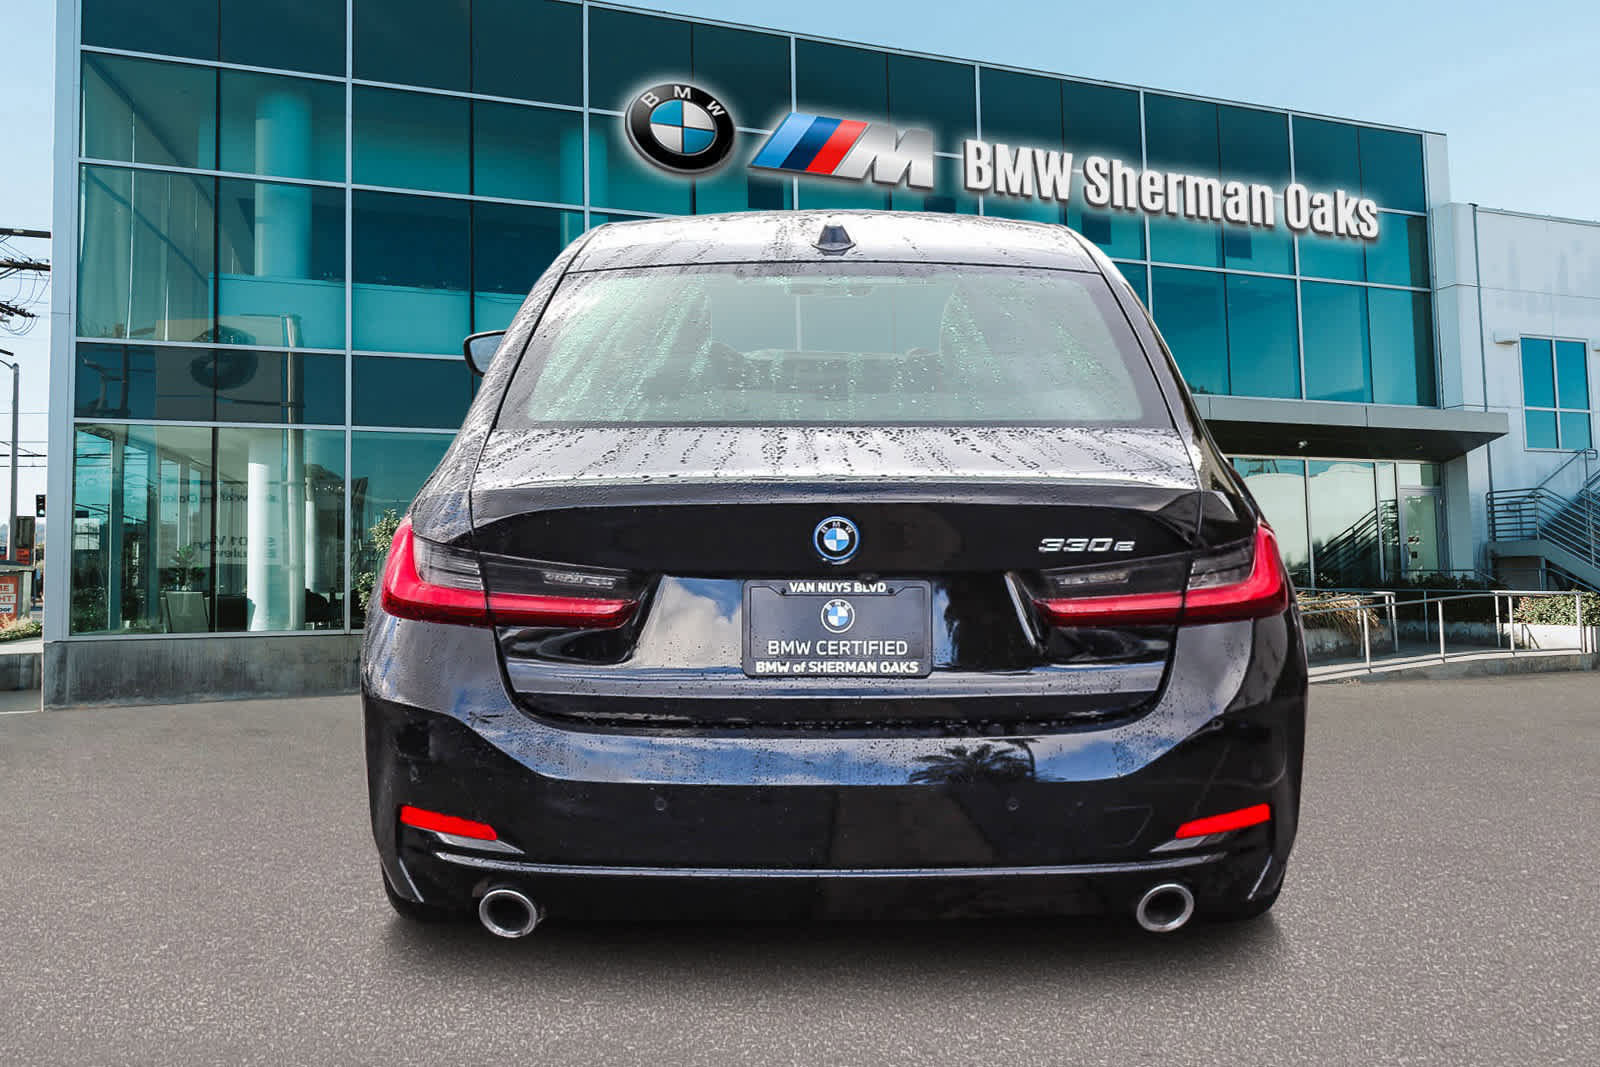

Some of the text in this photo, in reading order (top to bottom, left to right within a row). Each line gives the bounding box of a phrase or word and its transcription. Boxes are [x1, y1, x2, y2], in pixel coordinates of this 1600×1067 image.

[640, 84, 725, 118] BMW
[963, 139, 1380, 240] BMW Sherman Oaks
[789, 582, 886, 593] VAN NUYS BLVD
[767, 640, 908, 655] BMW CERTIFIED
[755, 661, 919, 673] BMW of SHERMAN OAKS
